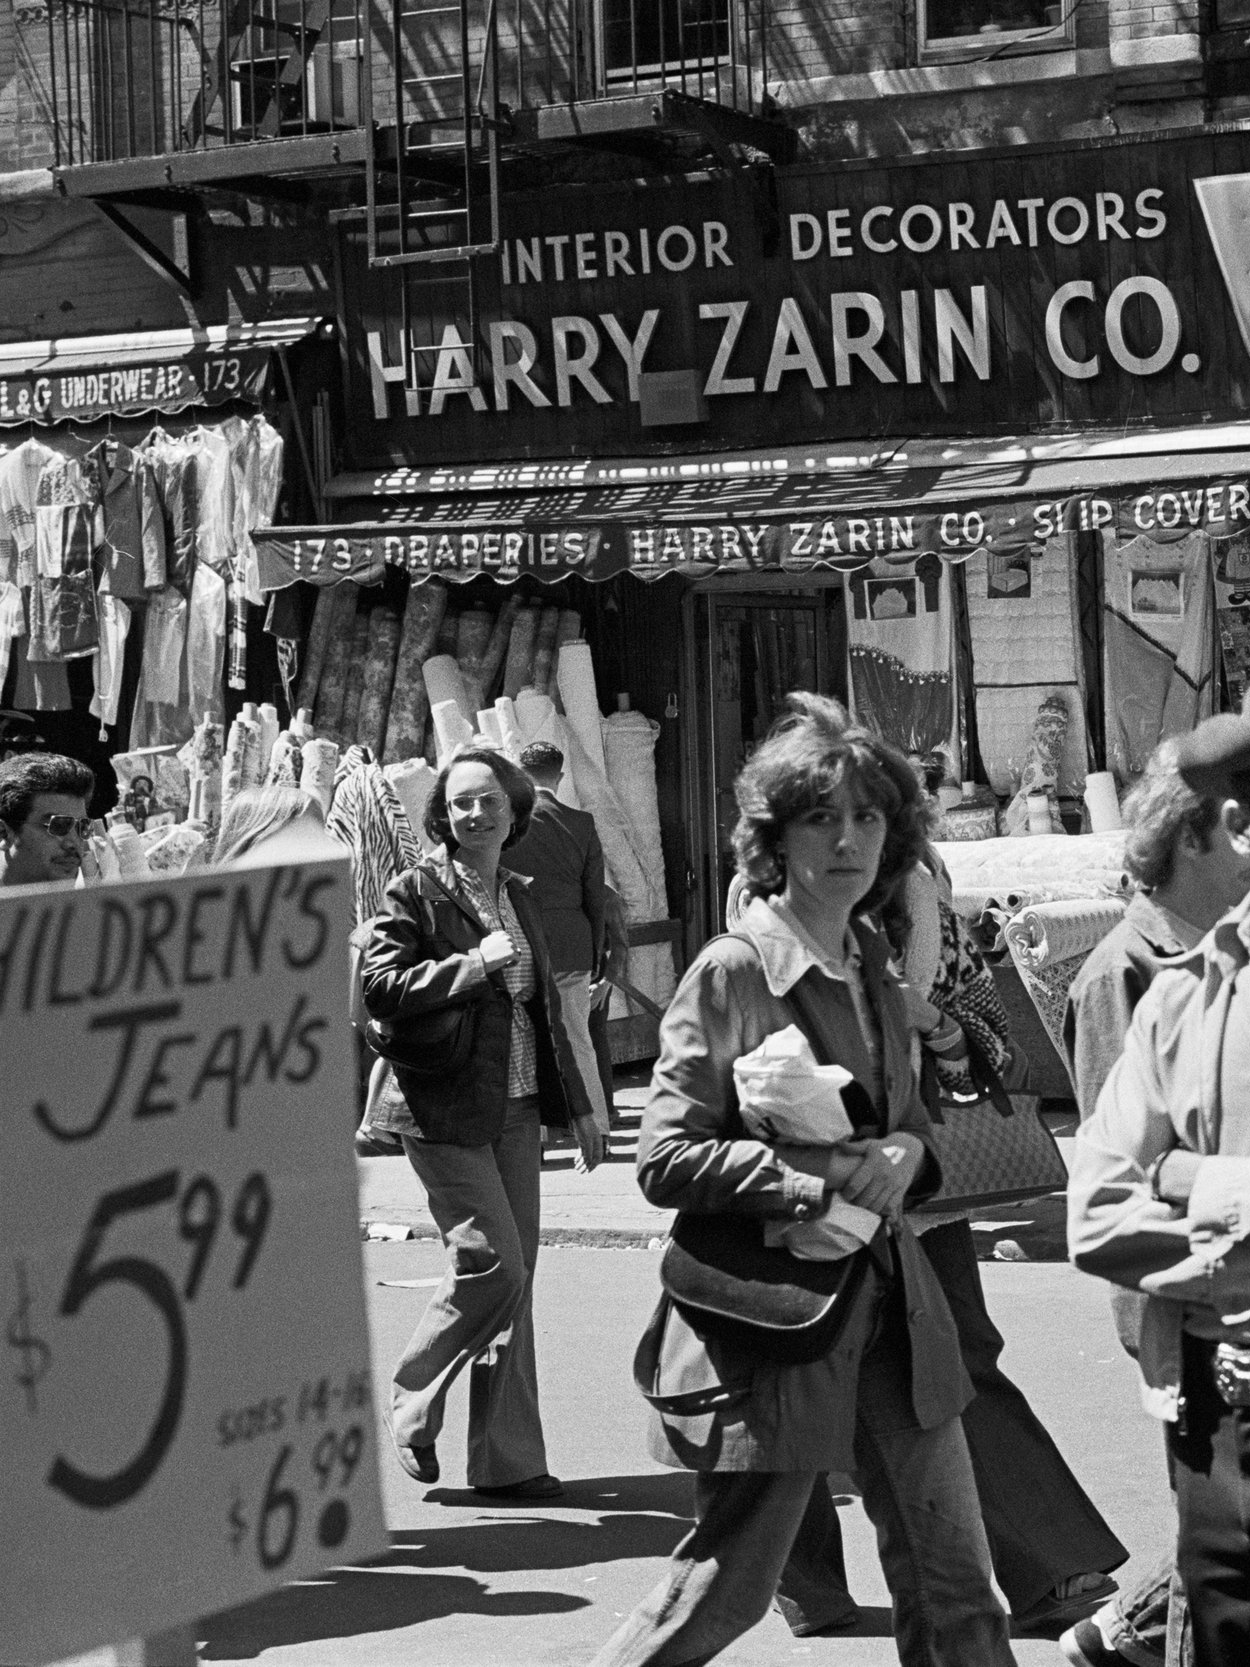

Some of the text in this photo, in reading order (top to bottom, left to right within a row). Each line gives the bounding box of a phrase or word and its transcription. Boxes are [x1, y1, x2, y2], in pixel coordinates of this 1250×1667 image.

[501, 188, 1167, 284] INTERIOR DECORATORS
[60, 365, 183, 409] UNDERWEAR
[202, 357, 241, 392] 173
[366, 275, 1201, 420] HARRY ZARIN CO.
[294, 538, 352, 573] 173
[384, 532, 586, 567] DRAPERIES
[630, 524, 770, 562] HARRY
[789, 515, 915, 556] ZARIN
[940, 511, 994, 546] CO.
[1032, 499, 1113, 539] SLIP
